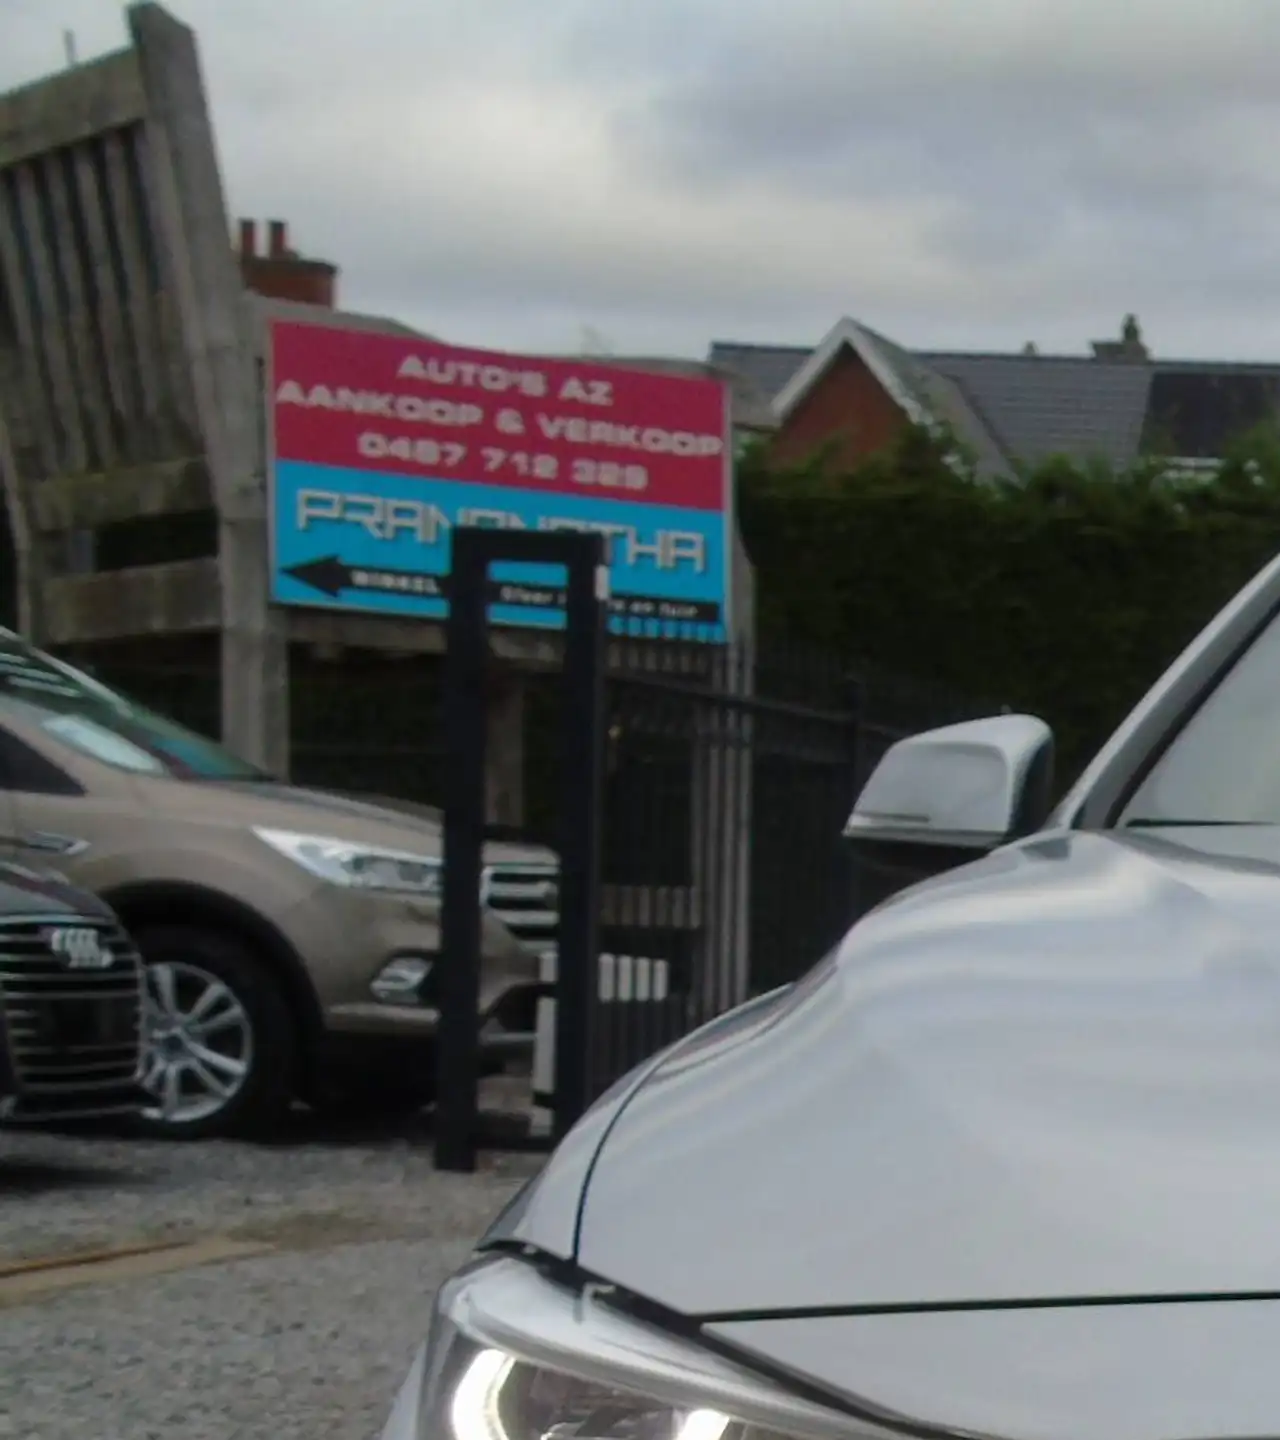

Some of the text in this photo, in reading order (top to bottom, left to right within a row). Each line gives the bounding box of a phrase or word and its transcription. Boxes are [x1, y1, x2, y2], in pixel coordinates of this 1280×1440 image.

[397, 354, 615, 406] AUTO'S AZ
[276, 379, 484, 426] AANKOOP
[536, 412, 724, 457] VERKOOP
